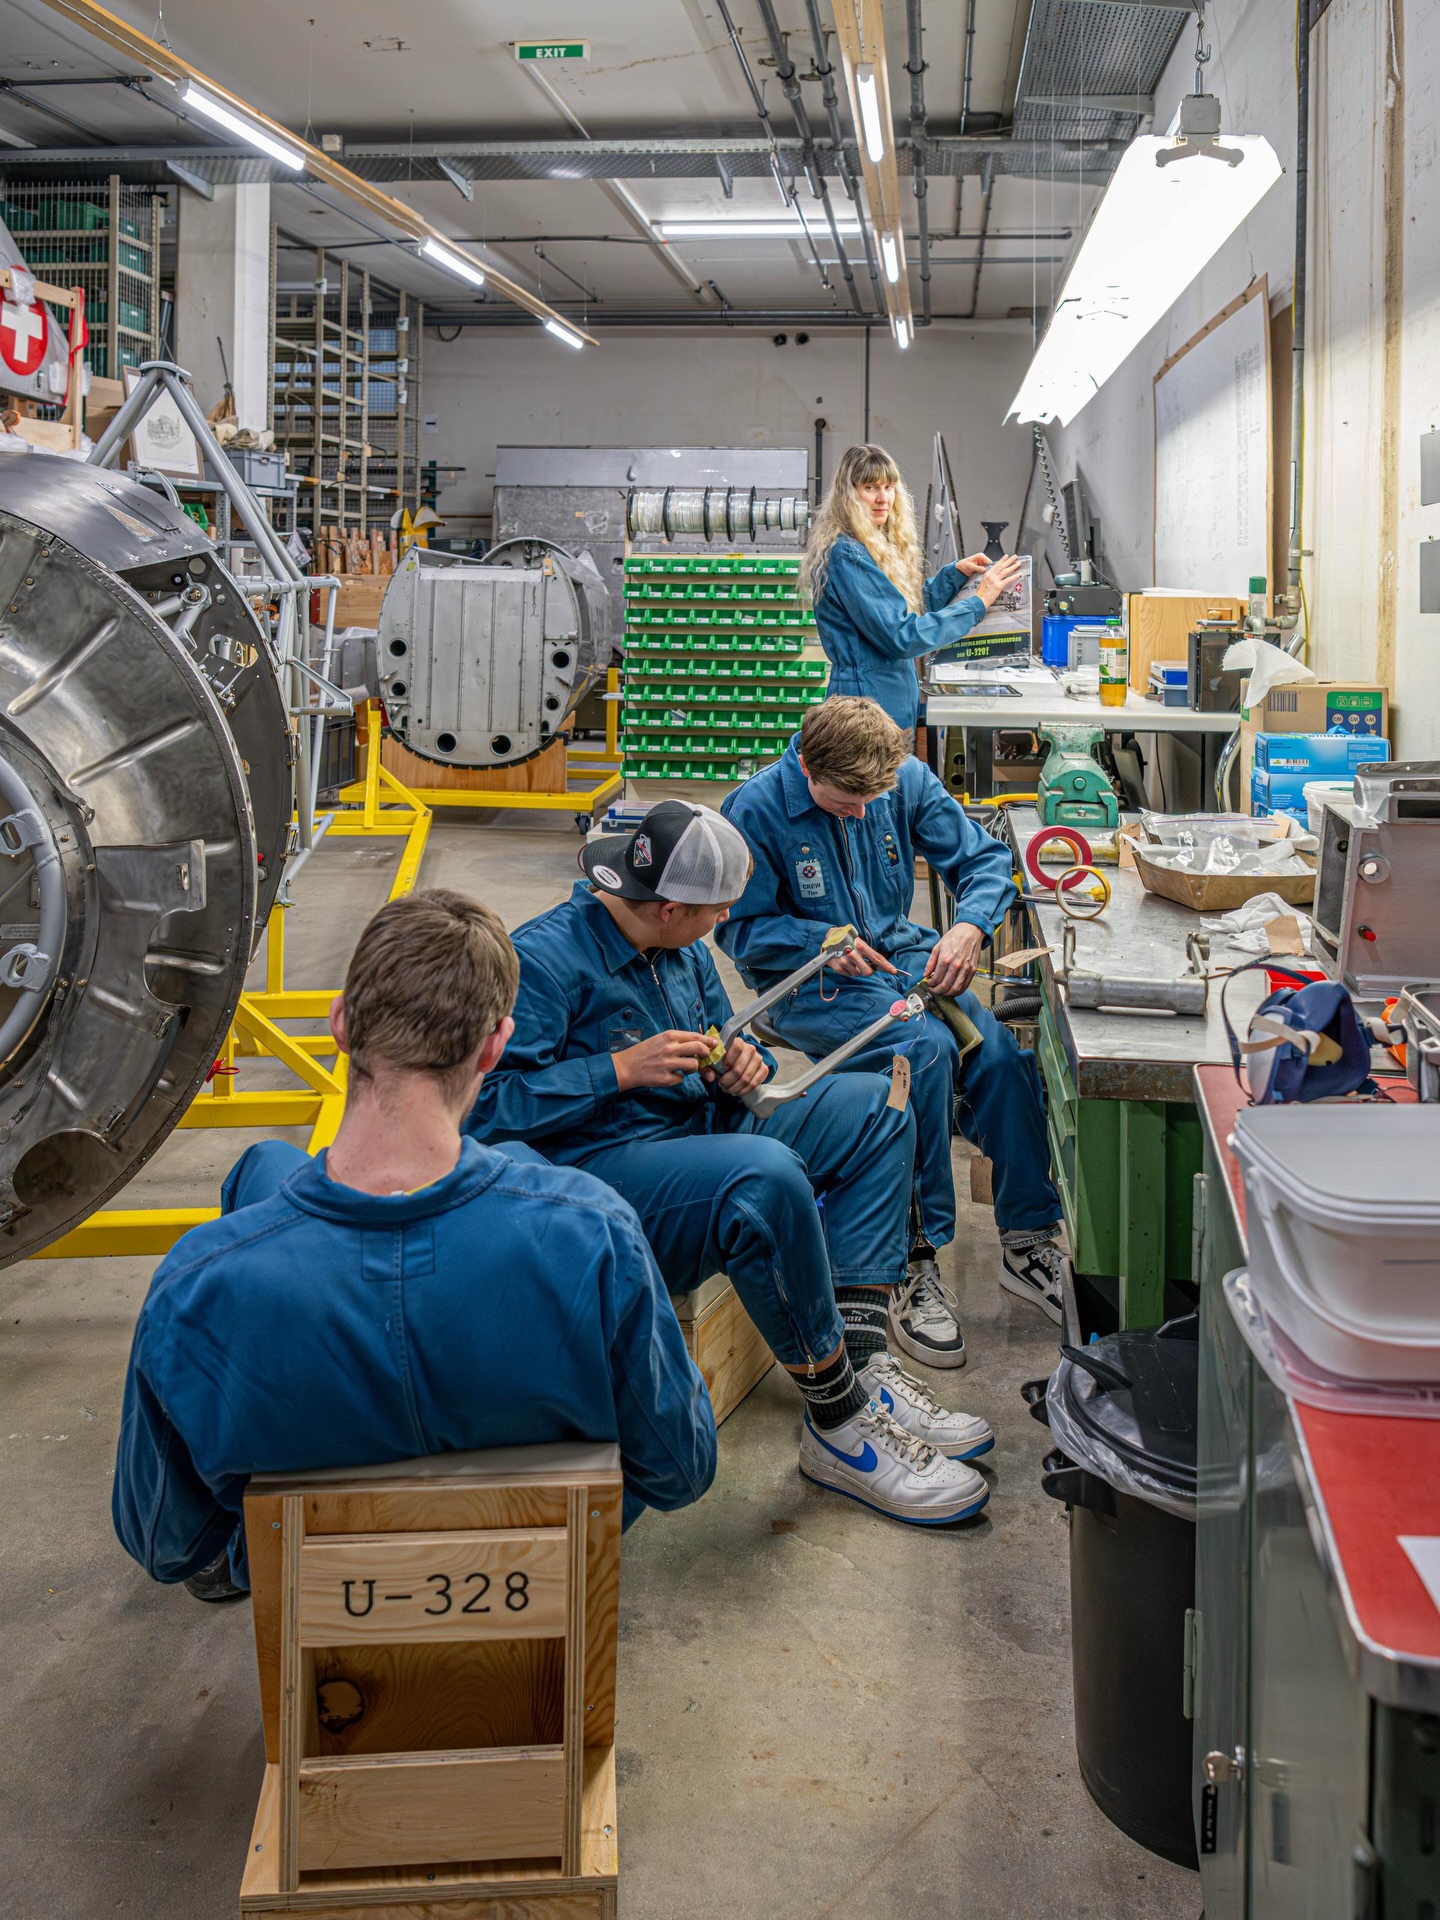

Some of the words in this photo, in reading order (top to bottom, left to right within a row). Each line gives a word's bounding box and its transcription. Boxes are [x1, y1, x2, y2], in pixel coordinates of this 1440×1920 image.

[535, 47, 567, 58] EXIT
[966, 646, 990, 657] U-328!
[802, 882, 821, 890] CREW
[342, 1571, 530, 1617] U-328
